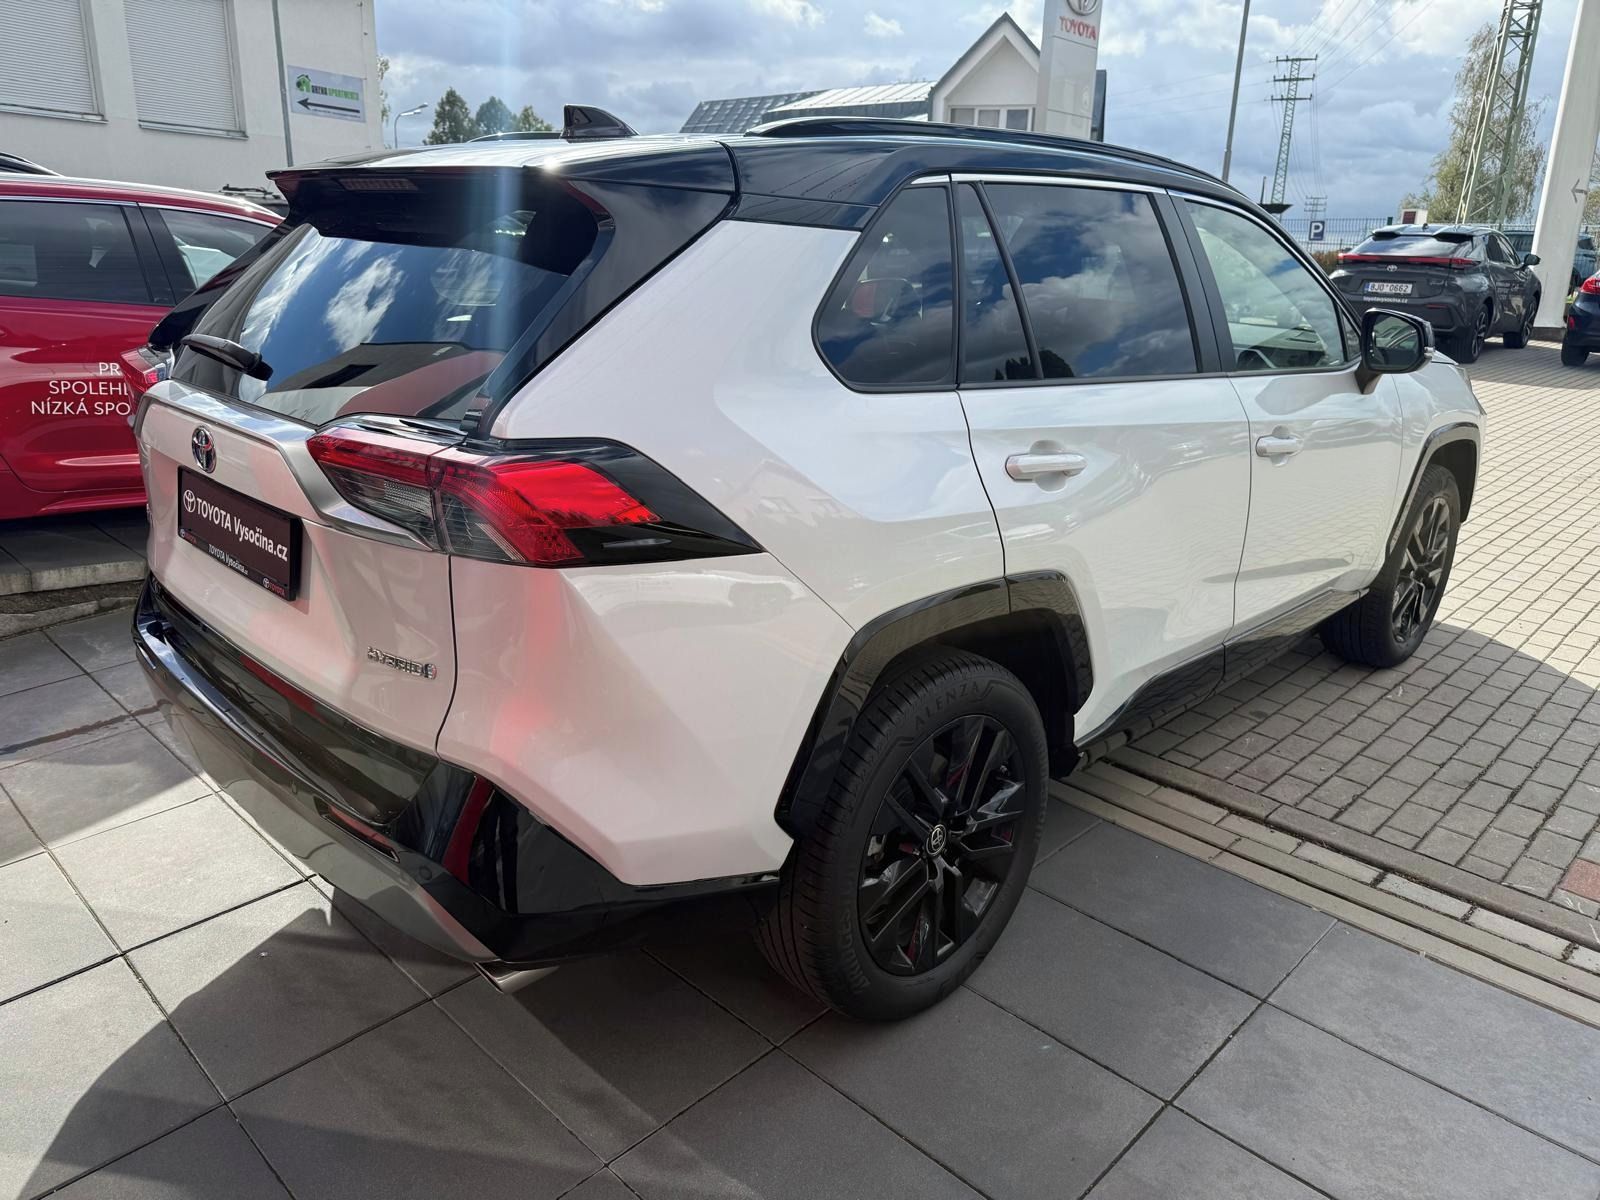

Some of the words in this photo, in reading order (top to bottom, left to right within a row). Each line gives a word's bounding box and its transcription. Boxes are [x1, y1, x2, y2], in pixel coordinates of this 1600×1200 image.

[1059, 16, 1096, 40] TOYOTA
[1310, 222, 1323, 239] P
[98, 362, 121, 376] PR
[31, 396, 89, 415] NÍZKÁ
[94, 401, 131, 416] SPO
[196, 498, 232, 532] TOYOTA
[233, 516, 288, 561] Vysočina.cz
[208, 543, 226, 563] TOYOTA
[270, 583, 286, 597] TOYOTA
[367, 646, 424, 676] HYBRID
[915, 681, 980, 731] ALENZA
